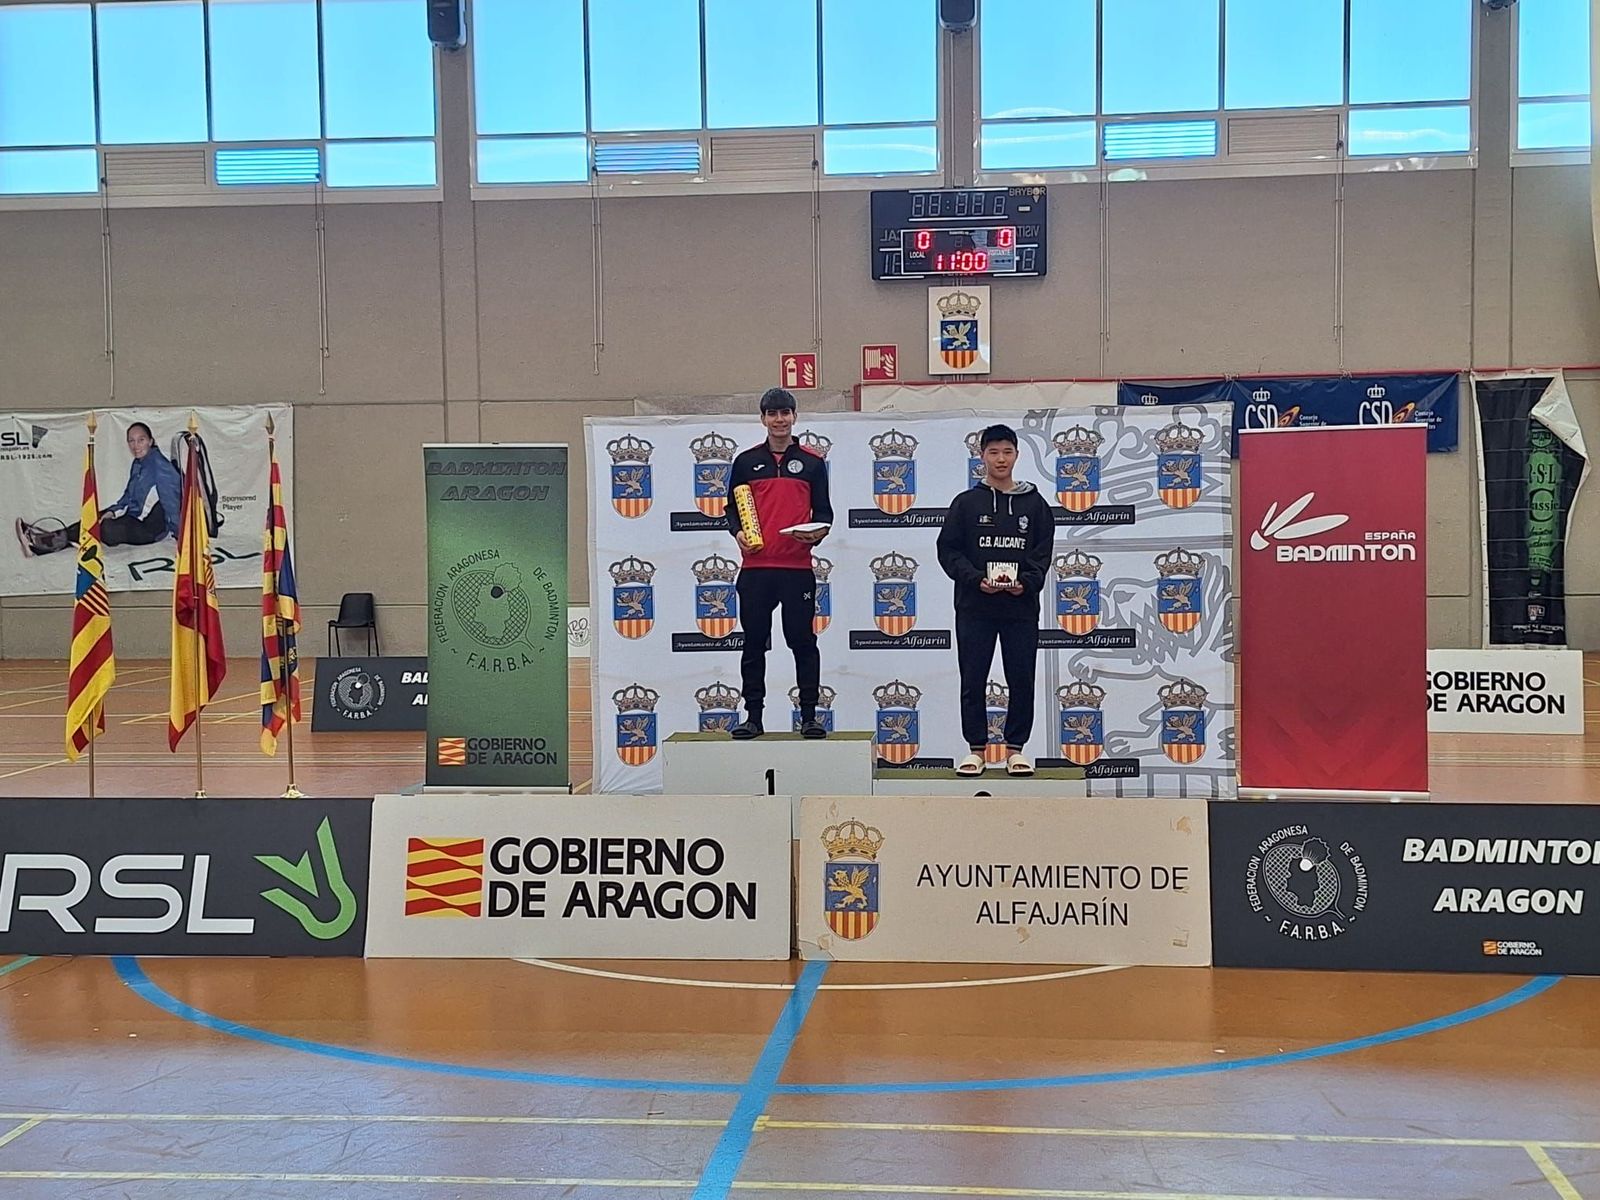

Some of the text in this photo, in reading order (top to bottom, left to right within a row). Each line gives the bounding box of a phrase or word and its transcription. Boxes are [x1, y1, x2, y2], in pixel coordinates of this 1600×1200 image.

[917, 231, 930, 250] 0
[999, 228, 1012, 247] 0
[909, 251, 925, 259] LOCAL
[936, 251, 987, 271] 11:00
[0, 431, 29, 446] SL
[440, 485, 549, 501] ARAGON
[222, 503, 243, 511] Player
[979, 536, 1027, 550] C.B. ALICANTE
[1364, 530, 1416, 541] ESPAÑA
[1276, 544, 1416, 562] BADMINTON
[432, 549, 560, 644] FEDERACION ARAGONESA DE BADMINTON
[1457, 693, 1565, 714] ARAGON
[467, 737, 546, 751] GOBIERNO
[468, 752, 557, 765] DE ARAGON
[489, 837, 725, 875] GOBIERNO
[916, 864, 1189, 891] AYUNTAMIENTO DE
[1246, 825, 1369, 912] FEDERACION ARAGONESA DE BADMINTON
[0, 854, 255, 934] RSL
[487, 880, 758, 920] DE ARAGON
[1432, 887, 1584, 914] ARAGON
[976, 897, 1129, 926] ALFAJARÍN
[1497, 941, 1536, 949] GOBIERNO
